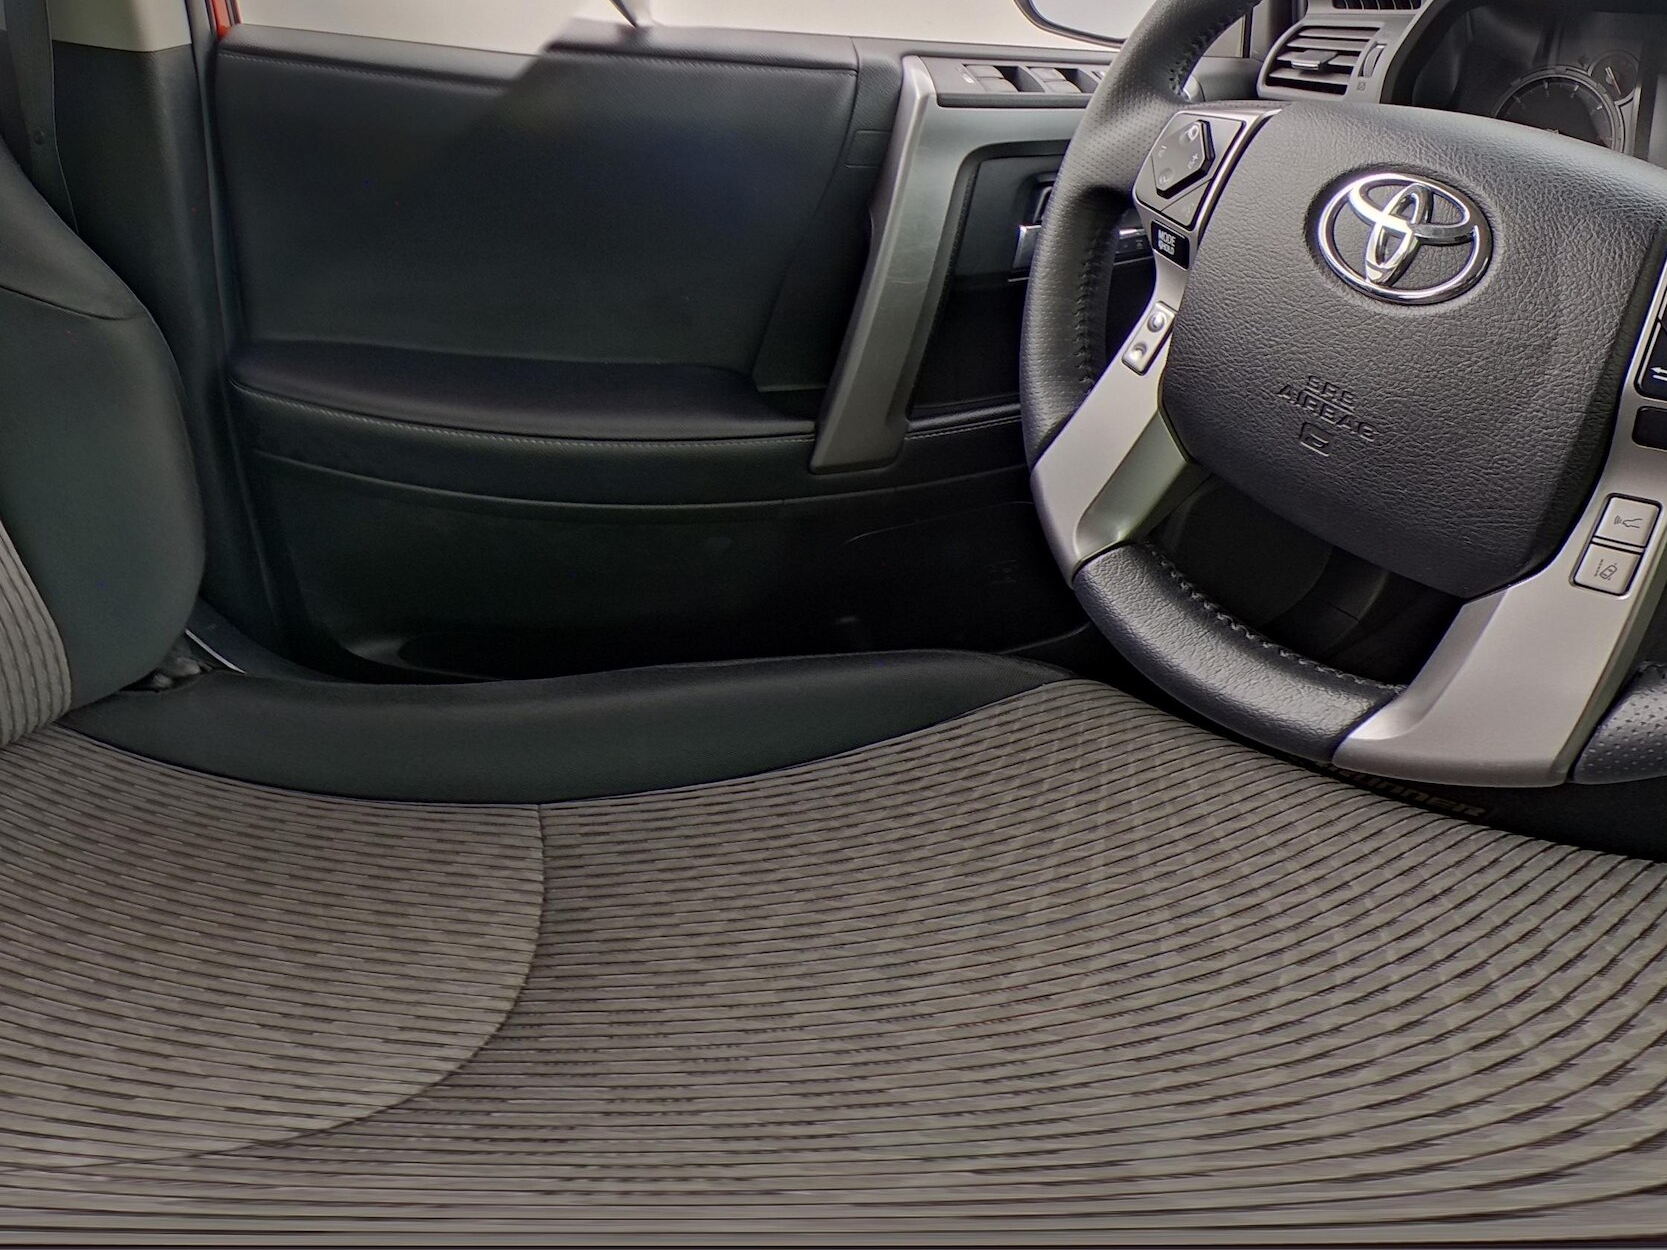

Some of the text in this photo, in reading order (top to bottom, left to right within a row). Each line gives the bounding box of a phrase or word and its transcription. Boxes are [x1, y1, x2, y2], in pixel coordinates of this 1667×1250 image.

[1158, 228, 1177, 248] MODE
[1306, 374, 1357, 409] SRS
[1276, 384, 1381, 443] AIRBAG
